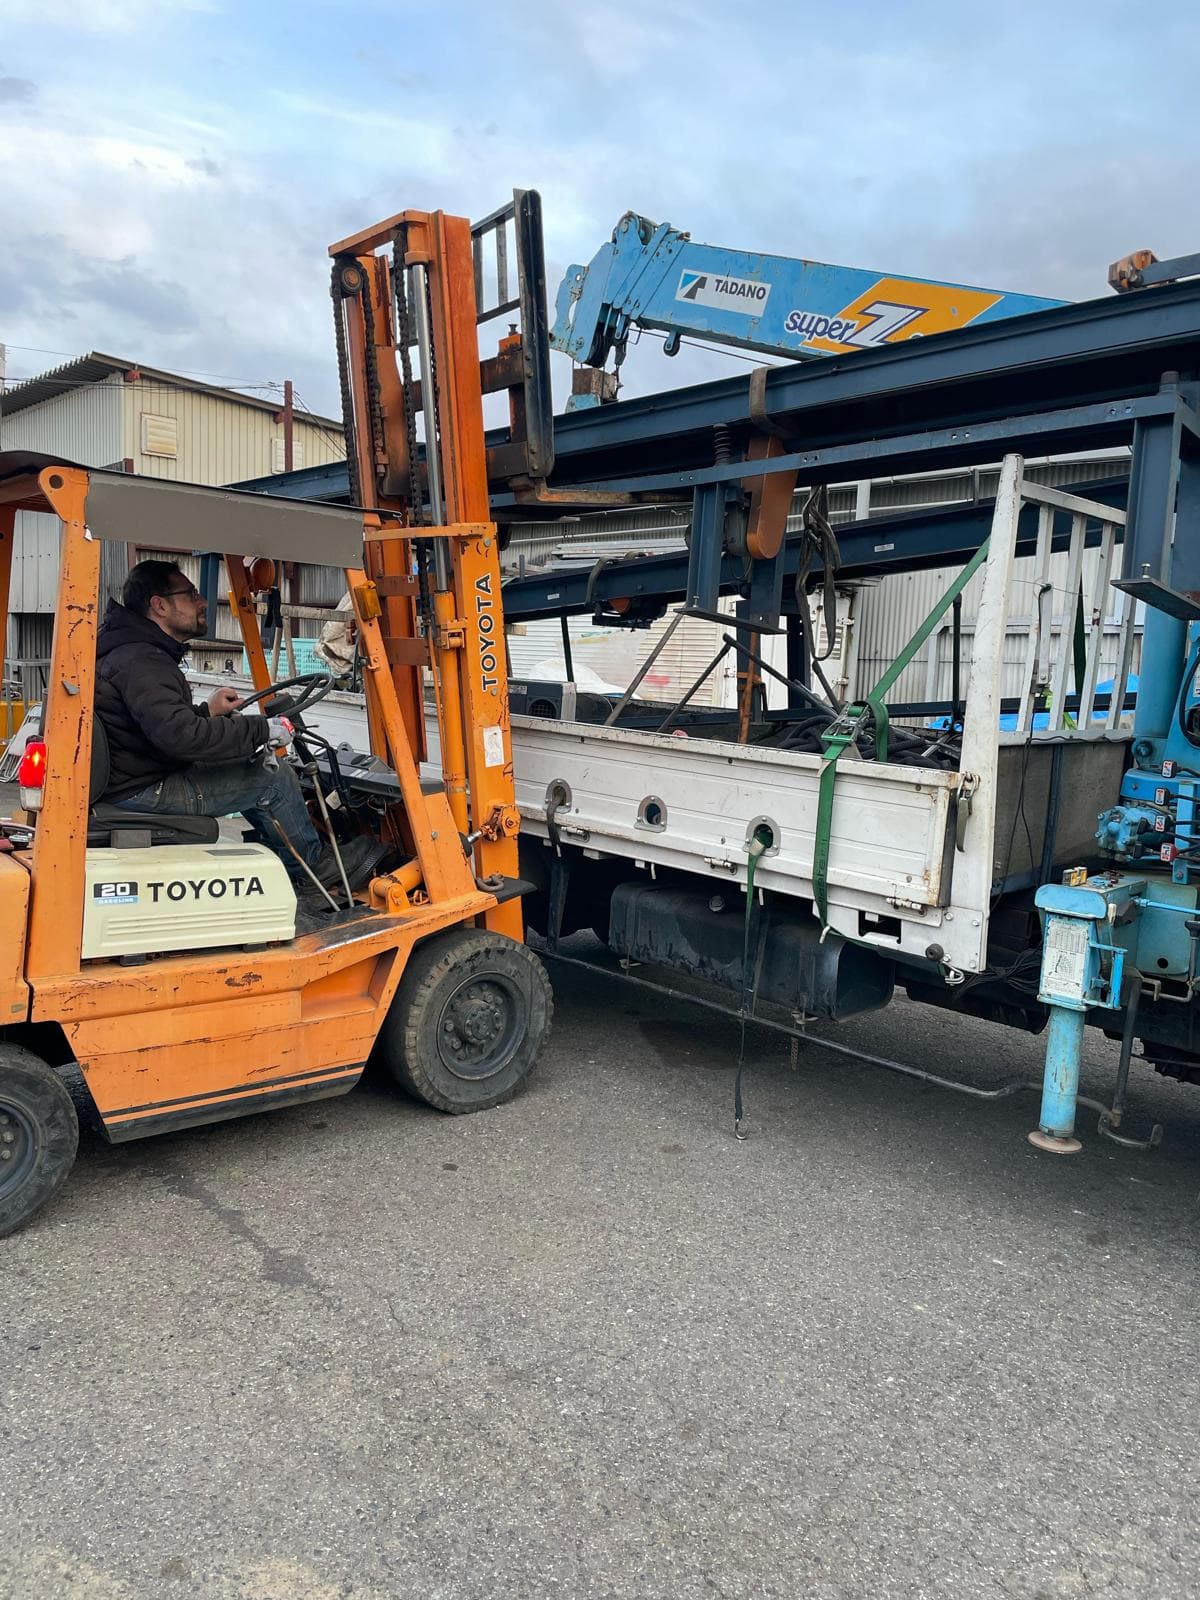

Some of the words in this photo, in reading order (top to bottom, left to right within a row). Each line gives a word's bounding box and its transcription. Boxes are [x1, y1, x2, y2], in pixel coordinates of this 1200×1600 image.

[714, 279, 767, 301] TADANO
[785, 310, 858, 341] super
[475, 573, 498, 692] TOYOTA
[101, 883, 131, 897] 20
[147, 876, 265, 903] TOYOTA
